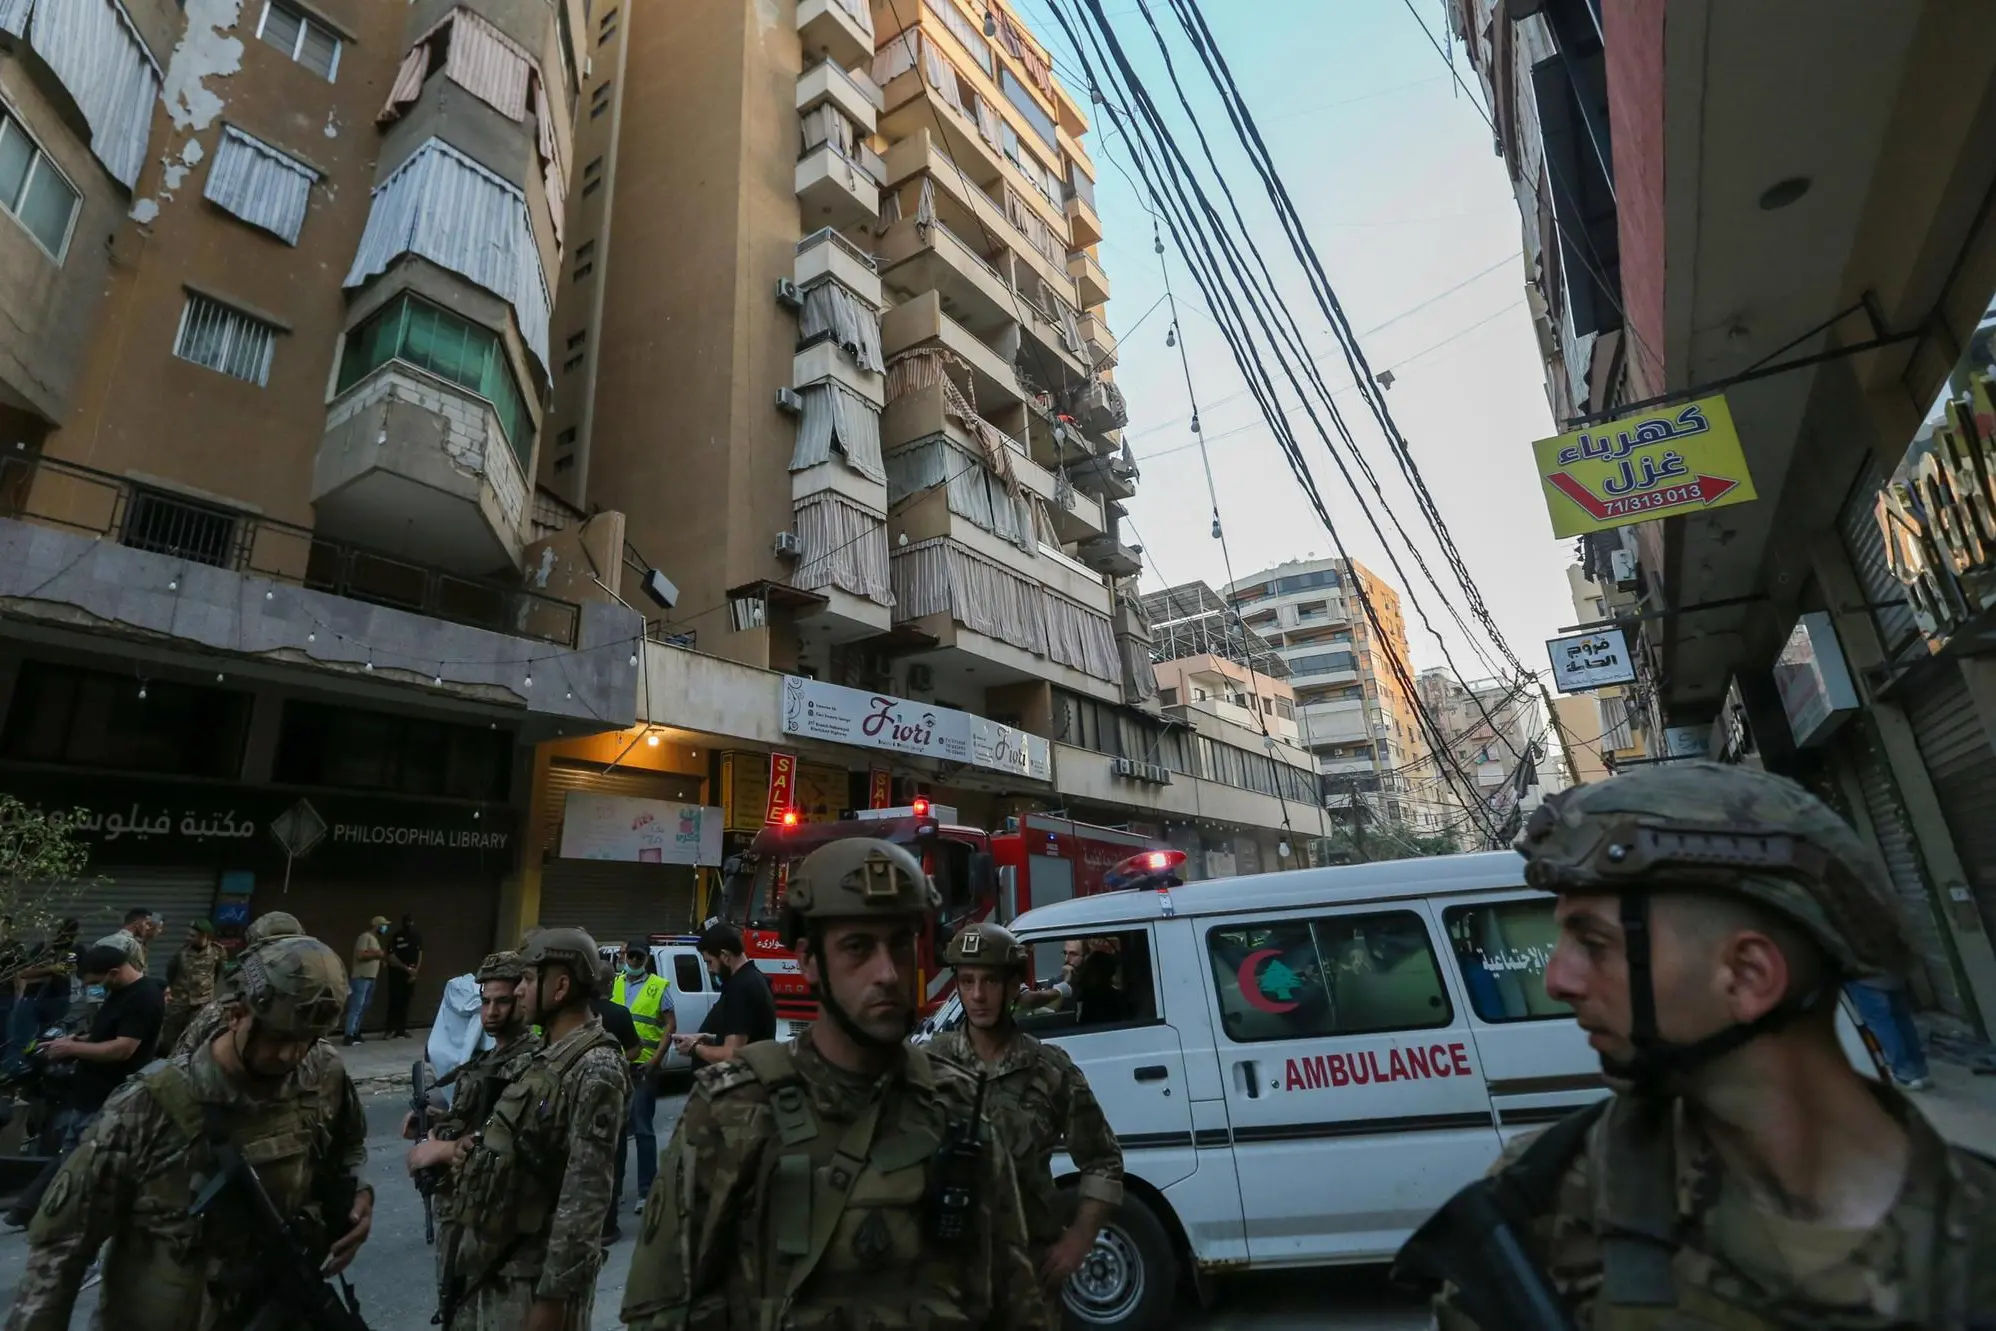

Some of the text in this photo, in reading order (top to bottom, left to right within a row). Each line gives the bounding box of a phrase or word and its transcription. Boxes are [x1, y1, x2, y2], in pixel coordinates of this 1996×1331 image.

[1558, 404, 1709, 464] كهرباء
[1603, 451, 1688, 494] غزل
[1604, 485, 1701, 516] 71/313 013
[862, 696, 932, 746] Fiori
[769, 758, 790, 821] SALE
[873, 774, 888, 808] SA
[179, 807, 255, 843] مكتبة
[333, 823, 508, 849] PHILOSOPHIA LIBRARY
[1285, 1043, 1472, 1092] AMBULANCE
